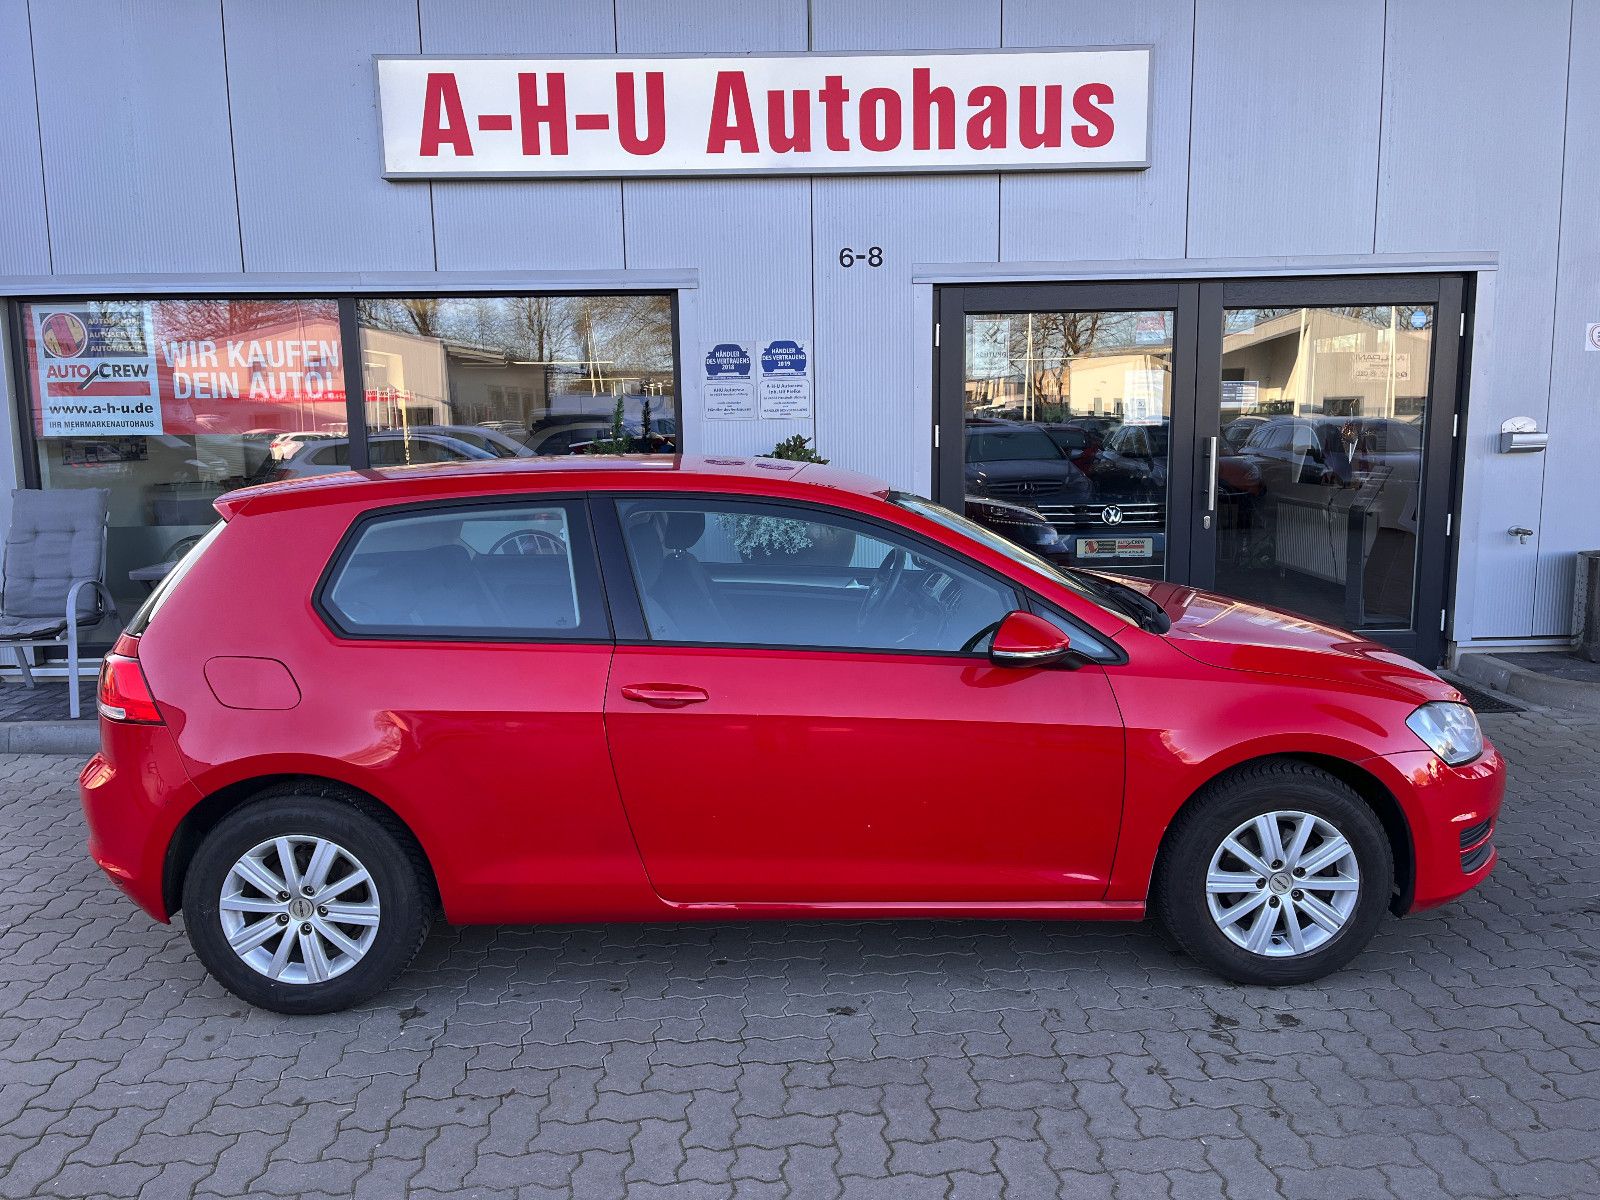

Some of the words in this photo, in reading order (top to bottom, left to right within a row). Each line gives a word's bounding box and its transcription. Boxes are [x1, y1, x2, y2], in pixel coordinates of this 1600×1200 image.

[420, 72, 666, 156] A-H-U
[706, 68, 1115, 154] Autohaus
[839, 246, 883, 268] 6-8
[161, 340, 218, 368] WIR
[227, 340, 339, 368] KAUFEN
[173, 372, 239, 399] DEIN
[250, 371, 333, 399] AUTO!
[49, 403, 154, 414] www.a-h-u.de
[64, 420, 154, 428] MEHRMARKENAUTOHAUS
